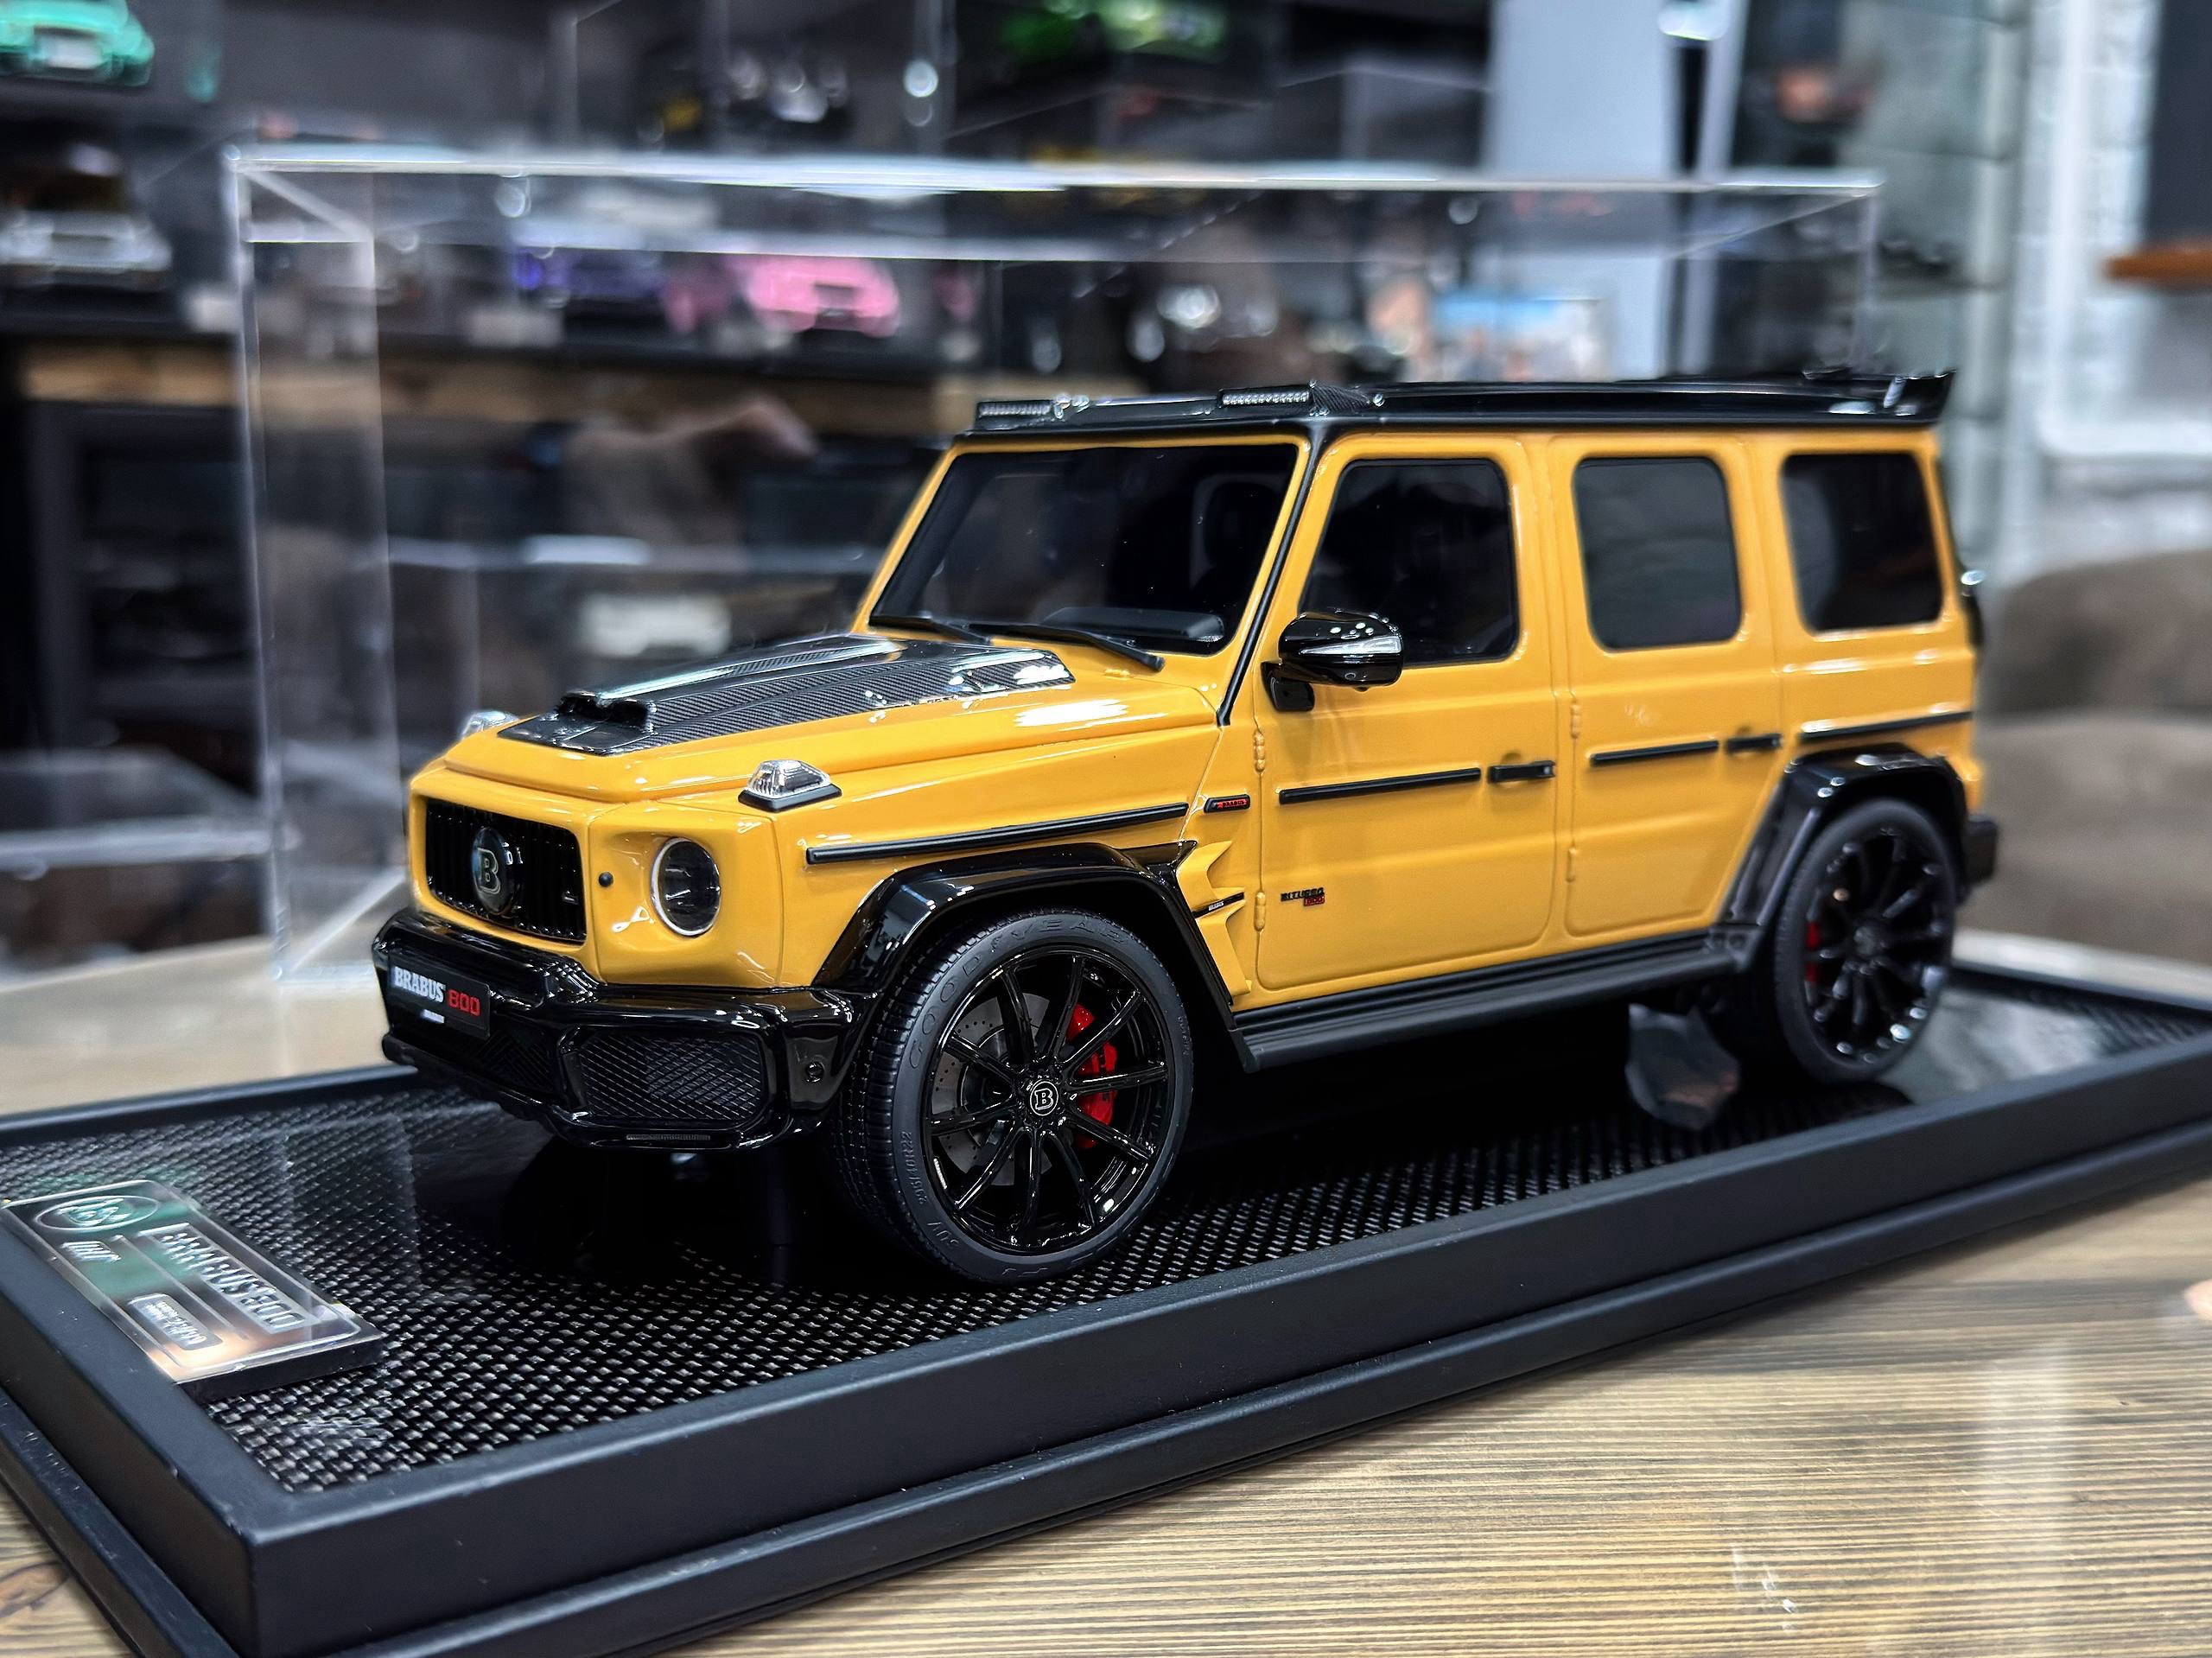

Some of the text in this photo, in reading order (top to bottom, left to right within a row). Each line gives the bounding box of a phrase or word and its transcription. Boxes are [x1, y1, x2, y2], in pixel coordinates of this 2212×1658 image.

[394, 966, 445, 1003] BRABUS
[448, 988, 480, 1017] 800
[908, 919, 1127, 1069] GOODYEAR
[1034, 1088, 1053, 1110] B
